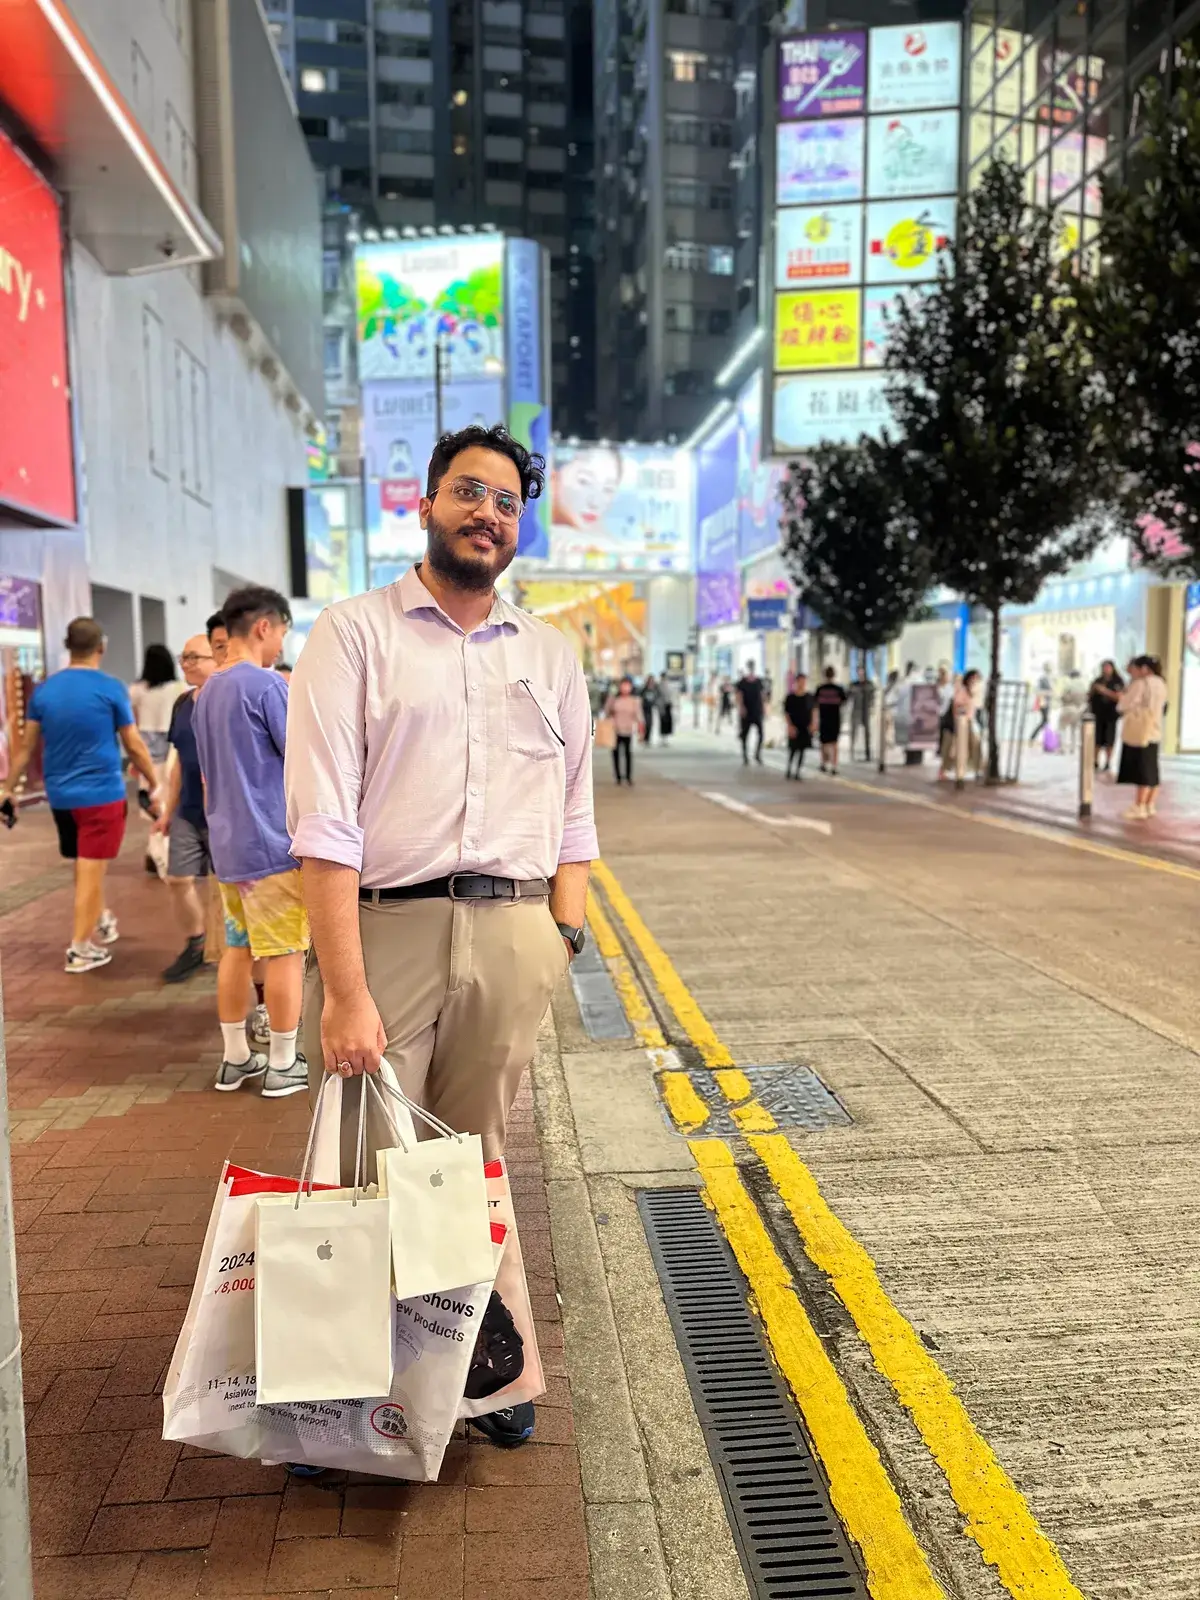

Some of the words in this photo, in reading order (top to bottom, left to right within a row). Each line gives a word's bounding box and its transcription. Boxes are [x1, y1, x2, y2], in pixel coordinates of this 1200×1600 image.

[219, 1251, 255, 1272] 2024
[414, 1311, 465, 1342] products
[278, 1408, 298, 1422] Kong
[319, 1404, 342, 1419] Kong
